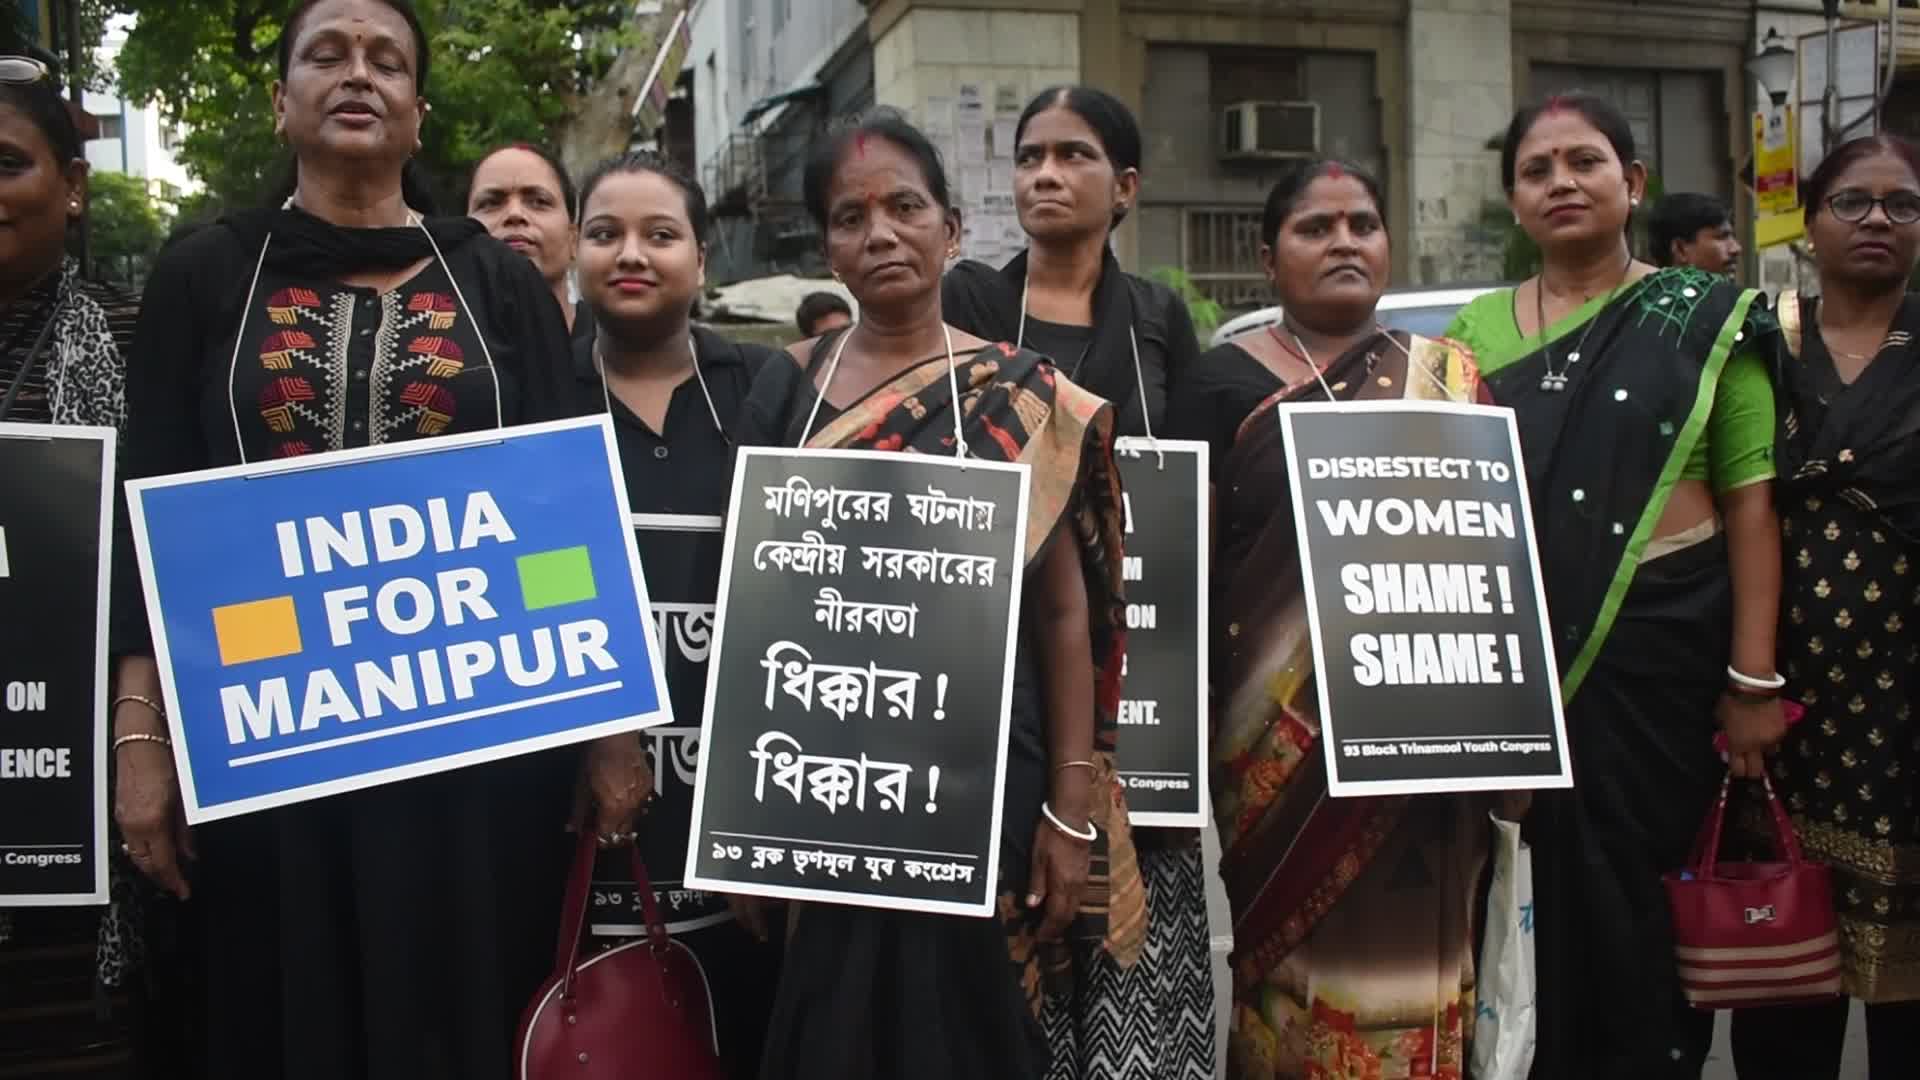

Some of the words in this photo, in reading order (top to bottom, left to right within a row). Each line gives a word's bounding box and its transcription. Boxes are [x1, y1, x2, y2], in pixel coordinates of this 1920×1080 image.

[1307, 456, 1472, 480] DISRESTECT
[1475, 459, 1510, 482] TO
[763, 476, 892, 529] মণিপুরের
[906, 485, 995, 531] ঘটনায়
[1316, 498, 1516, 538] WOMEN
[277, 492, 515, 577] INDIA
[754, 530, 846, 575] কেন্দ্রীয়
[861, 547, 997, 587] সরকারের
[324, 568, 497, 646] FOR
[814, 587, 919, 638] নীরবতা
[7, 681, 45, 711] ON
[221, 620, 618, 744] MANIPUR
[1344, 745, 1360, 756] 93
[1362, 744, 1398, 756] Block
[1400, 742, 1462, 754] Trinamool
[1463, 741, 1498, 752] Youth
[1500, 741, 1551, 753] Congress
[1129, 777, 1189, 791] Congress
[6, 853, 81, 866] Congress
[751, 846, 785, 868] ব্লক
[792, 850, 856, 877] তৃণমূল
[864, 857, 896, 880] যুব
[904, 861, 975, 883] কংগ্রেস
